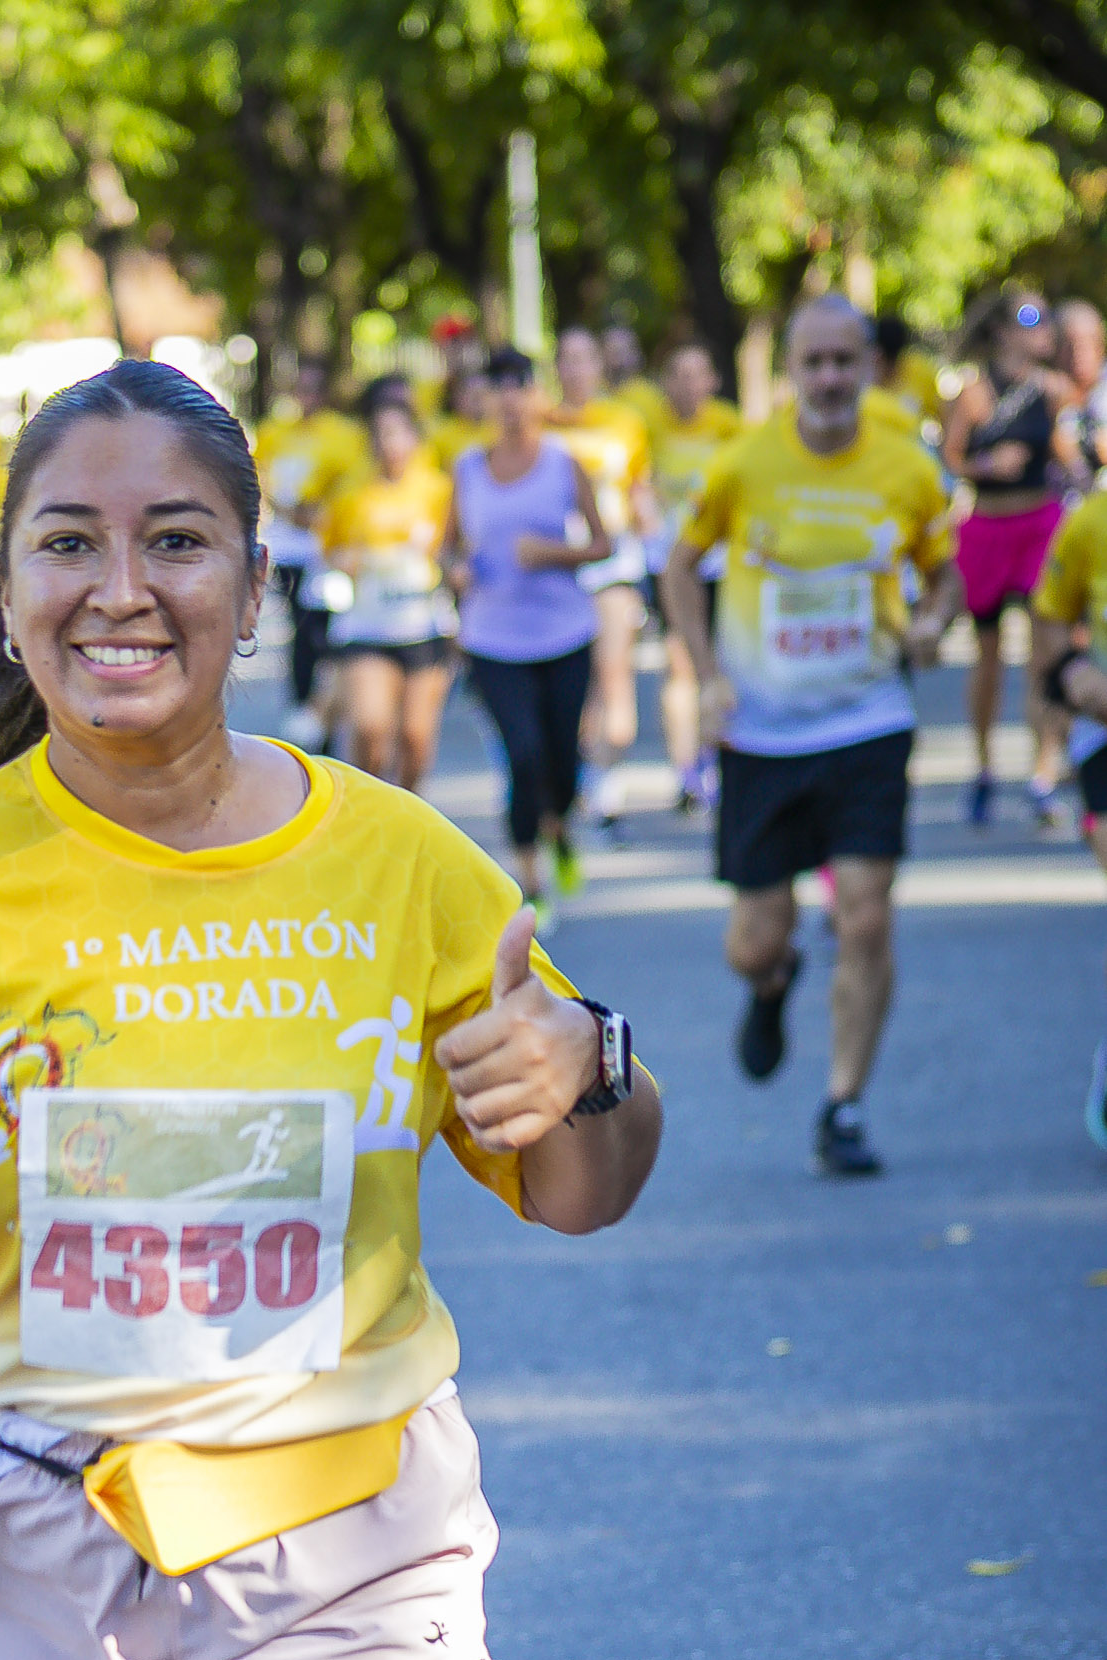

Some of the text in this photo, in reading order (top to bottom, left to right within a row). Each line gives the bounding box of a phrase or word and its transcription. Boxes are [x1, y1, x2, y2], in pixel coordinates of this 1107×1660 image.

[117, 909, 377, 967] MARATÓN
[114, 978, 340, 1023] DORADA
[30, 1220, 321, 1318] 4350
